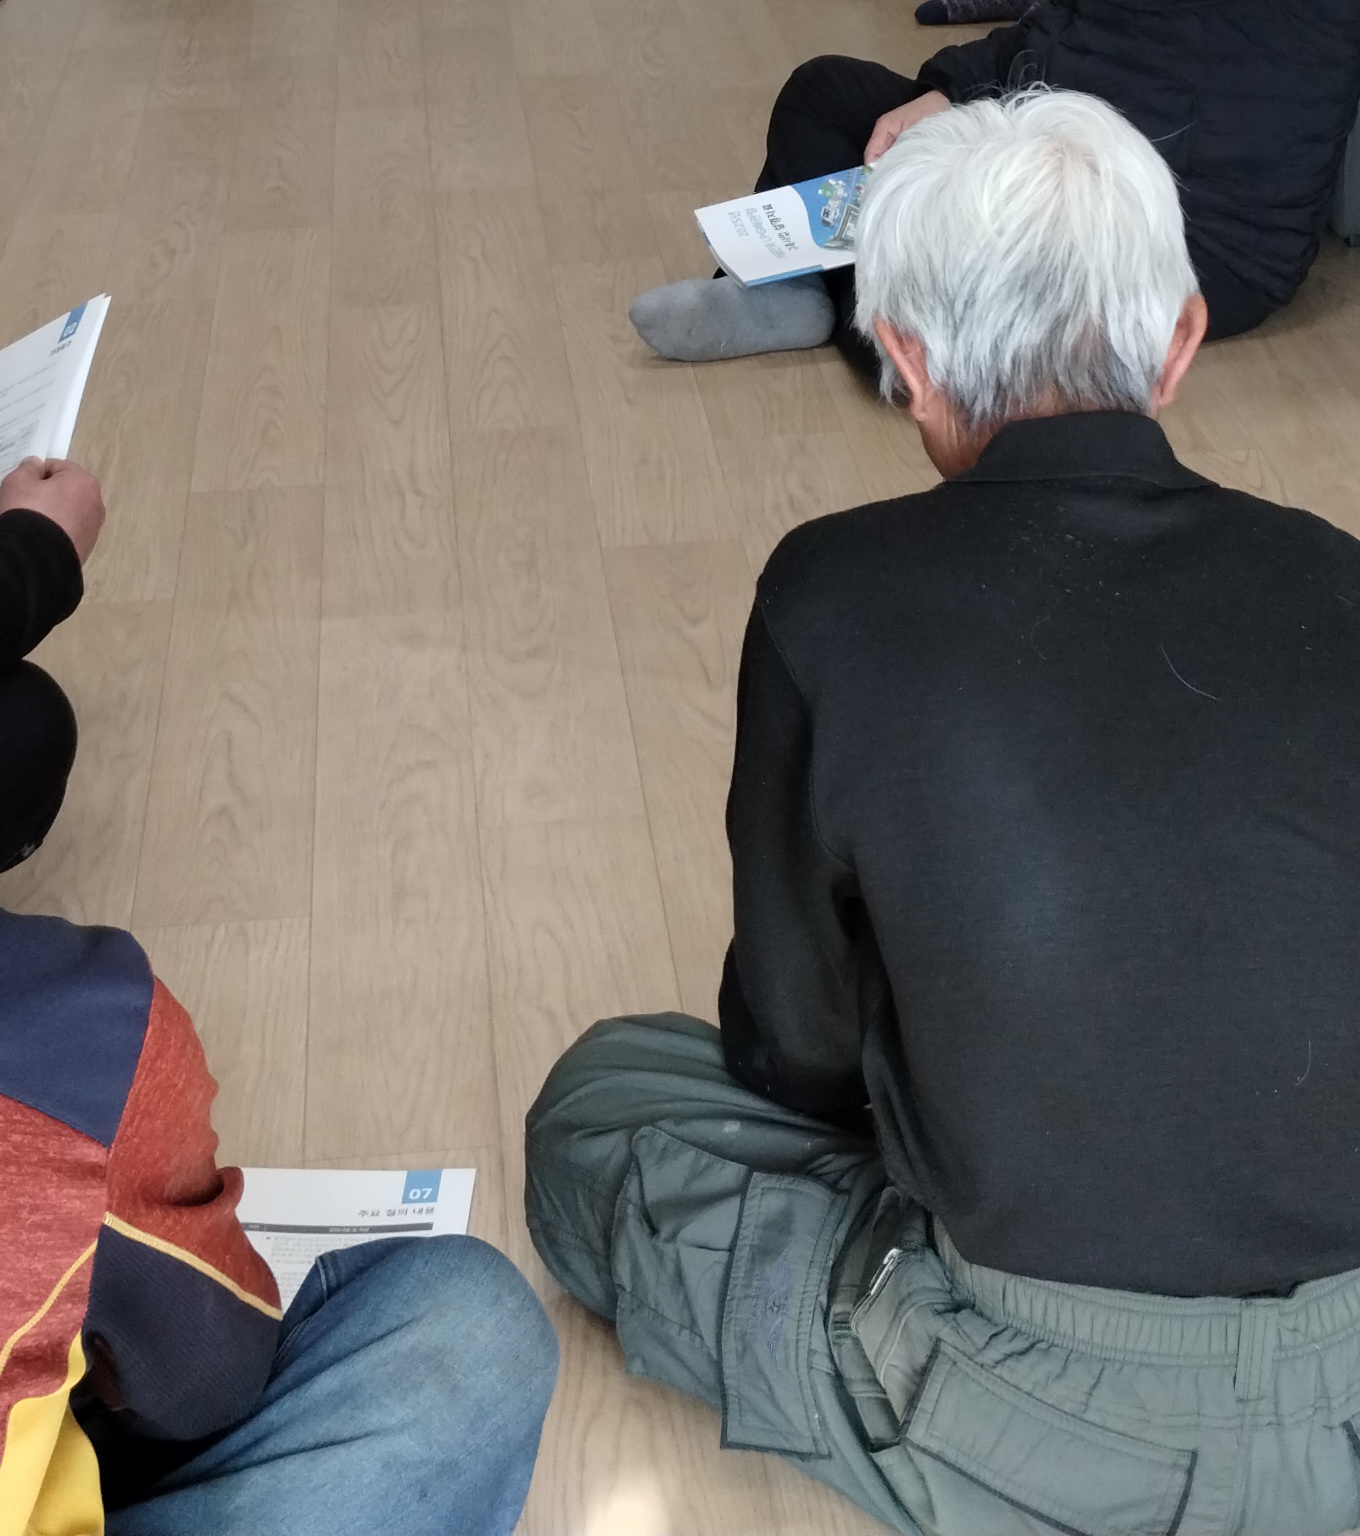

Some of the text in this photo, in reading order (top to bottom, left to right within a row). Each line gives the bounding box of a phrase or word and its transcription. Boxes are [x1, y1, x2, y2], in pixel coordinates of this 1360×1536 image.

[408, 1187, 433, 1200] 07
[357, 1206, 435, 1218] 주요 질의 내용
